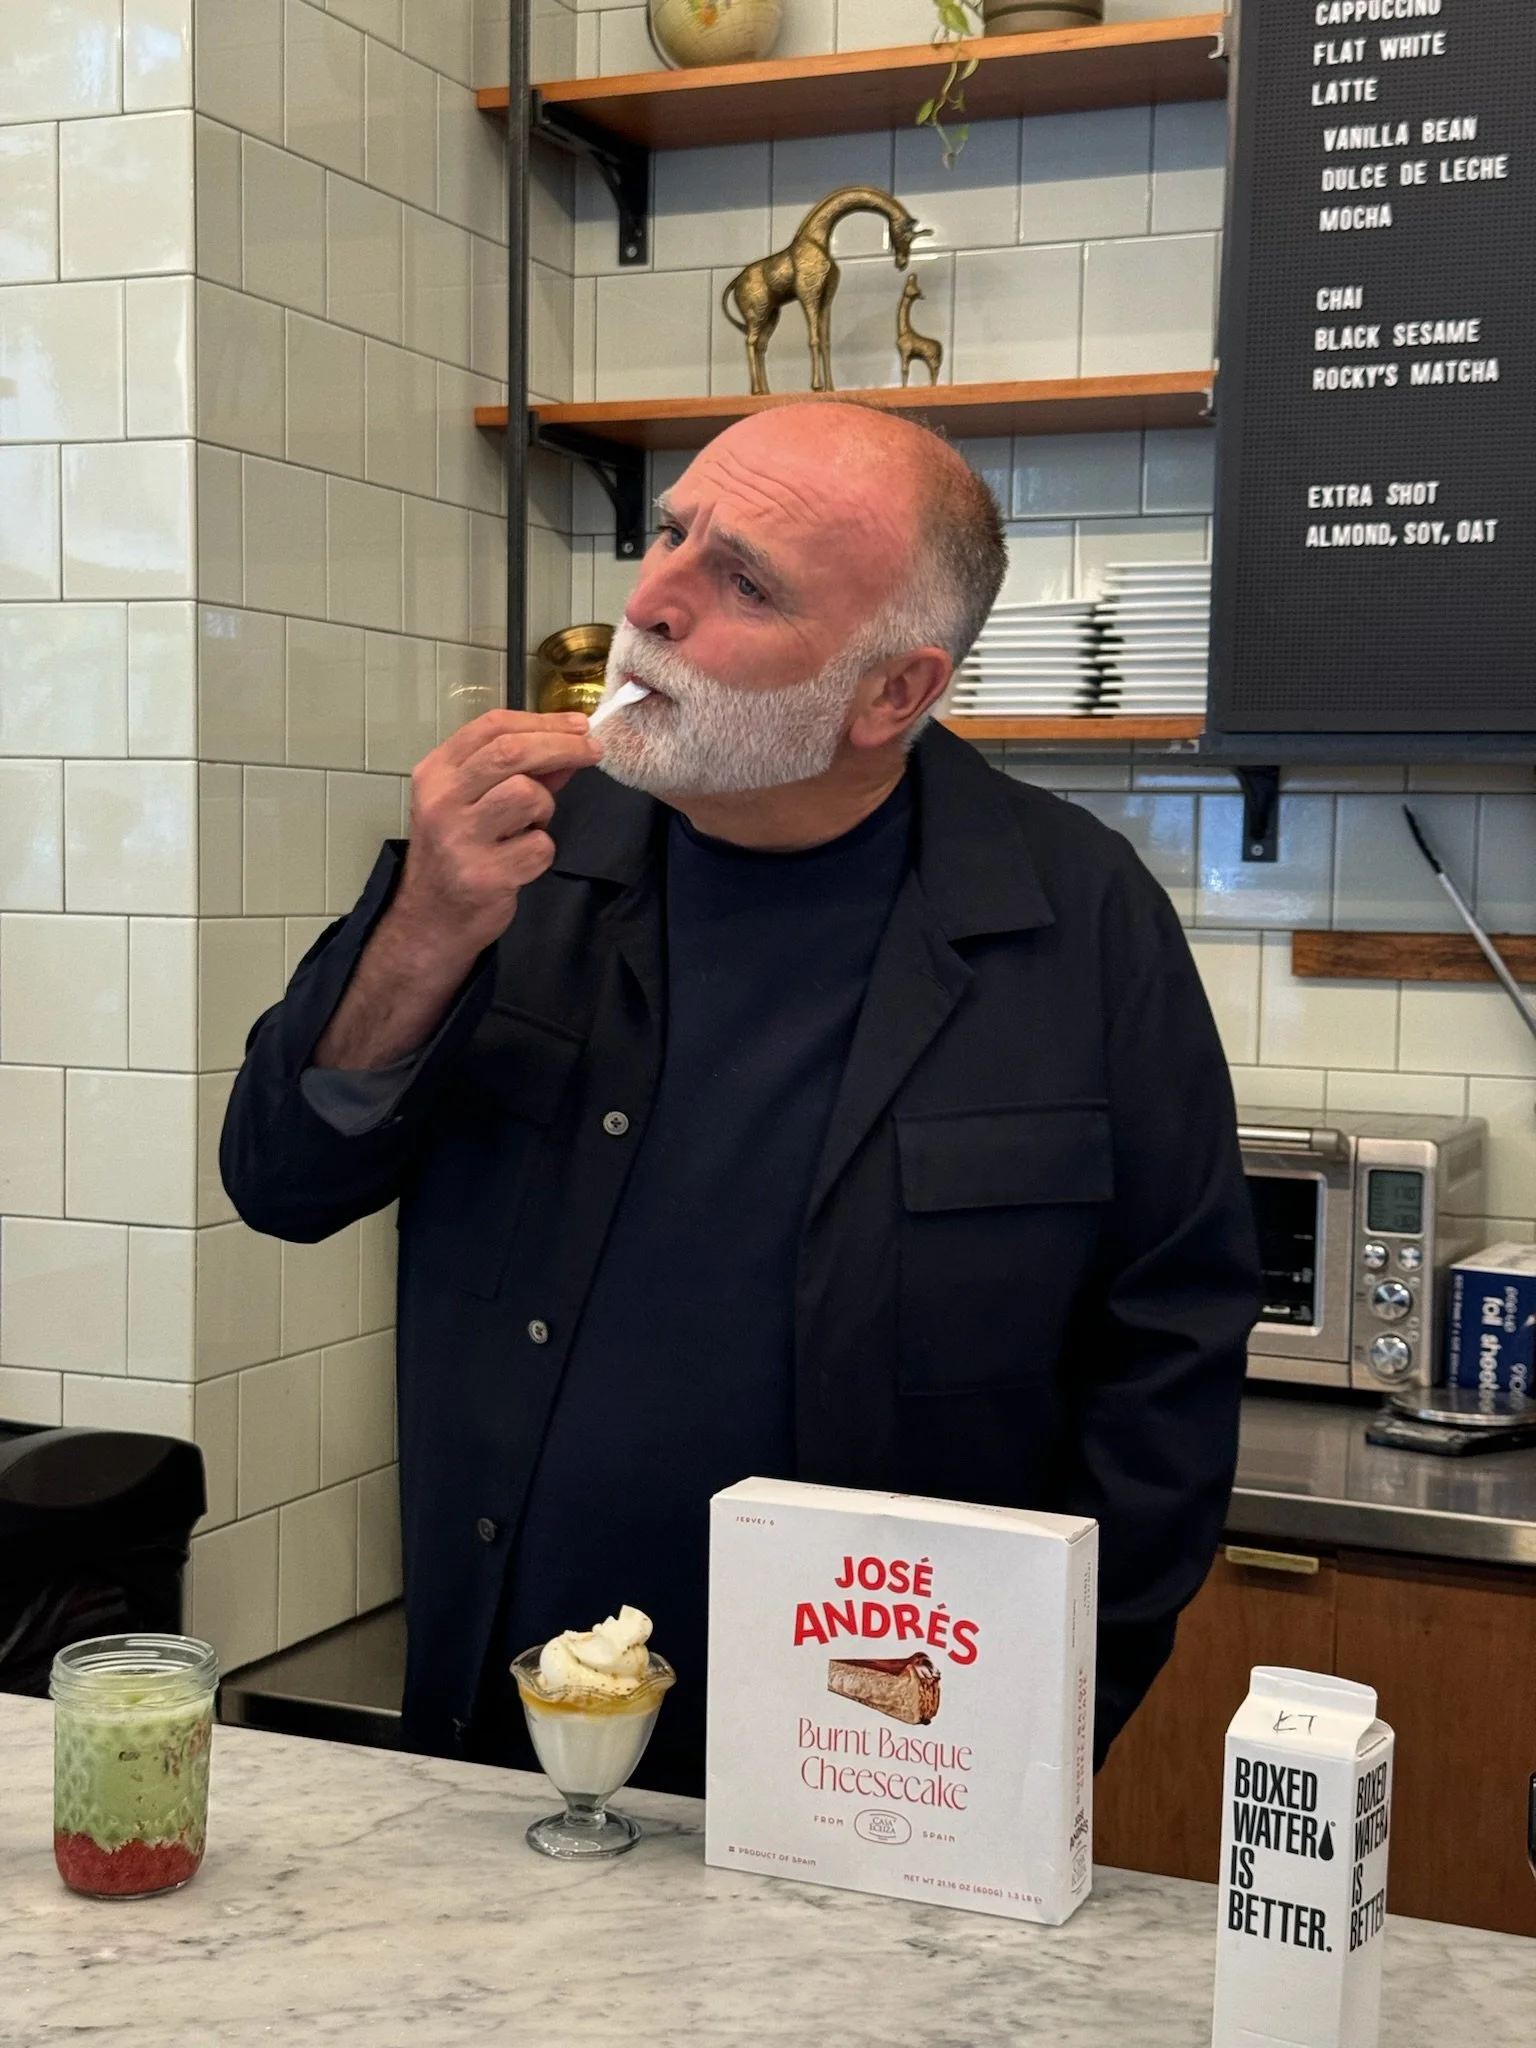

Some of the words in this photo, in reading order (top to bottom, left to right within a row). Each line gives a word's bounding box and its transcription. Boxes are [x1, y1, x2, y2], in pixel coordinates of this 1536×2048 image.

[1315, 0, 1442, 26] CAPPUCCINO
[1313, 38, 1367, 66] FLAT
[1379, 31, 1447, 60] WHITE
[1311, 77, 1379, 106] LATTE
[1323, 121, 1409, 152] VANILLA
[1421, 115, 1478, 144] BEAN
[1321, 163, 1388, 191] DULCE
[1400, 160, 1428, 186] DE
[1440, 155, 1509, 184] LECHE
[1319, 203, 1393, 231] MOCHA
[1316, 286, 1363, 311] CHAI
[1314, 325, 1380, 351] BLACK
[1393, 319, 1482, 347] SESAME
[1312, 364, 1399, 390] ROCKY'S
[1410, 358, 1500, 386] MATCHA
[1308, 484, 1373, 509] EXTRA
[1386, 481, 1440, 506] SHOT
[1305, 523, 1397, 548] ALMOND,
[1404, 521, 1450, 546] SOY,
[1456, 519, 1499, 544] OAT
[834, 1556, 934, 1598] JOSÉ
[793, 1600, 980, 1666] ANDRÉS
[798, 1717, 870, 1756] Burnt
[879, 1726, 973, 1772] Basque
[801, 1755, 969, 1811] Cheesecake
[1233, 1756, 1318, 1813] BOXED
[1356, 1761, 1387, 1818] BOXED
[814, 1815, 844, 1826] FROM
[922, 1831, 956, 1843] SPAIN
[1232, 1800, 1318, 1860] WATER
[1354, 1804, 1385, 1863] WATER
[739, 1847, 776, 1860] PRODUCT
[1229, 1844, 1256, 1890] IS
[1352, 1863, 1364, 1908] IS
[1227, 1888, 1333, 1953] BETTER.
